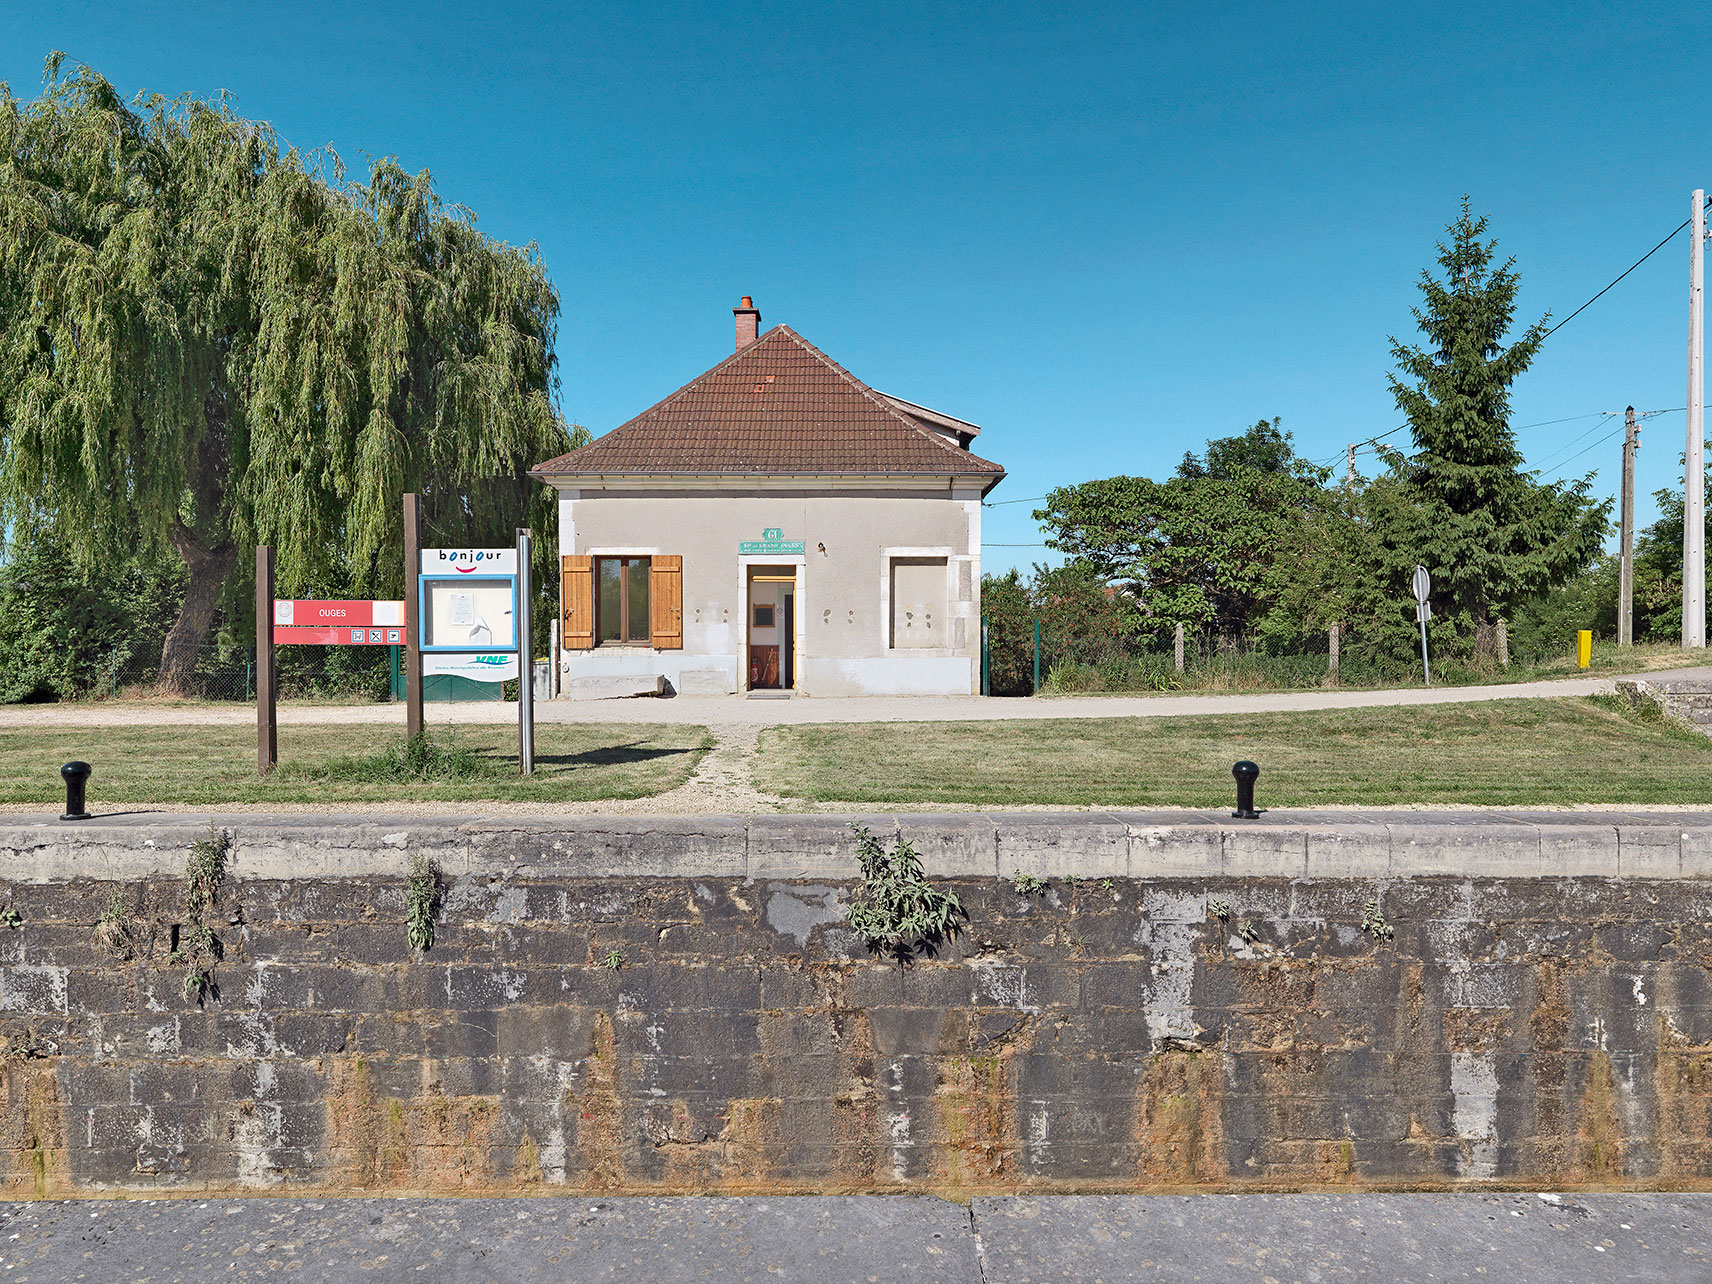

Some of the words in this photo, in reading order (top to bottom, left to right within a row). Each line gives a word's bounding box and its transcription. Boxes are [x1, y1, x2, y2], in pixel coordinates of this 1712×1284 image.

[768, 530, 777, 539] 61
[439, 550, 502, 563] bonjour
[319, 609, 347, 617] OUGES
[476, 655, 508, 663] VNF
